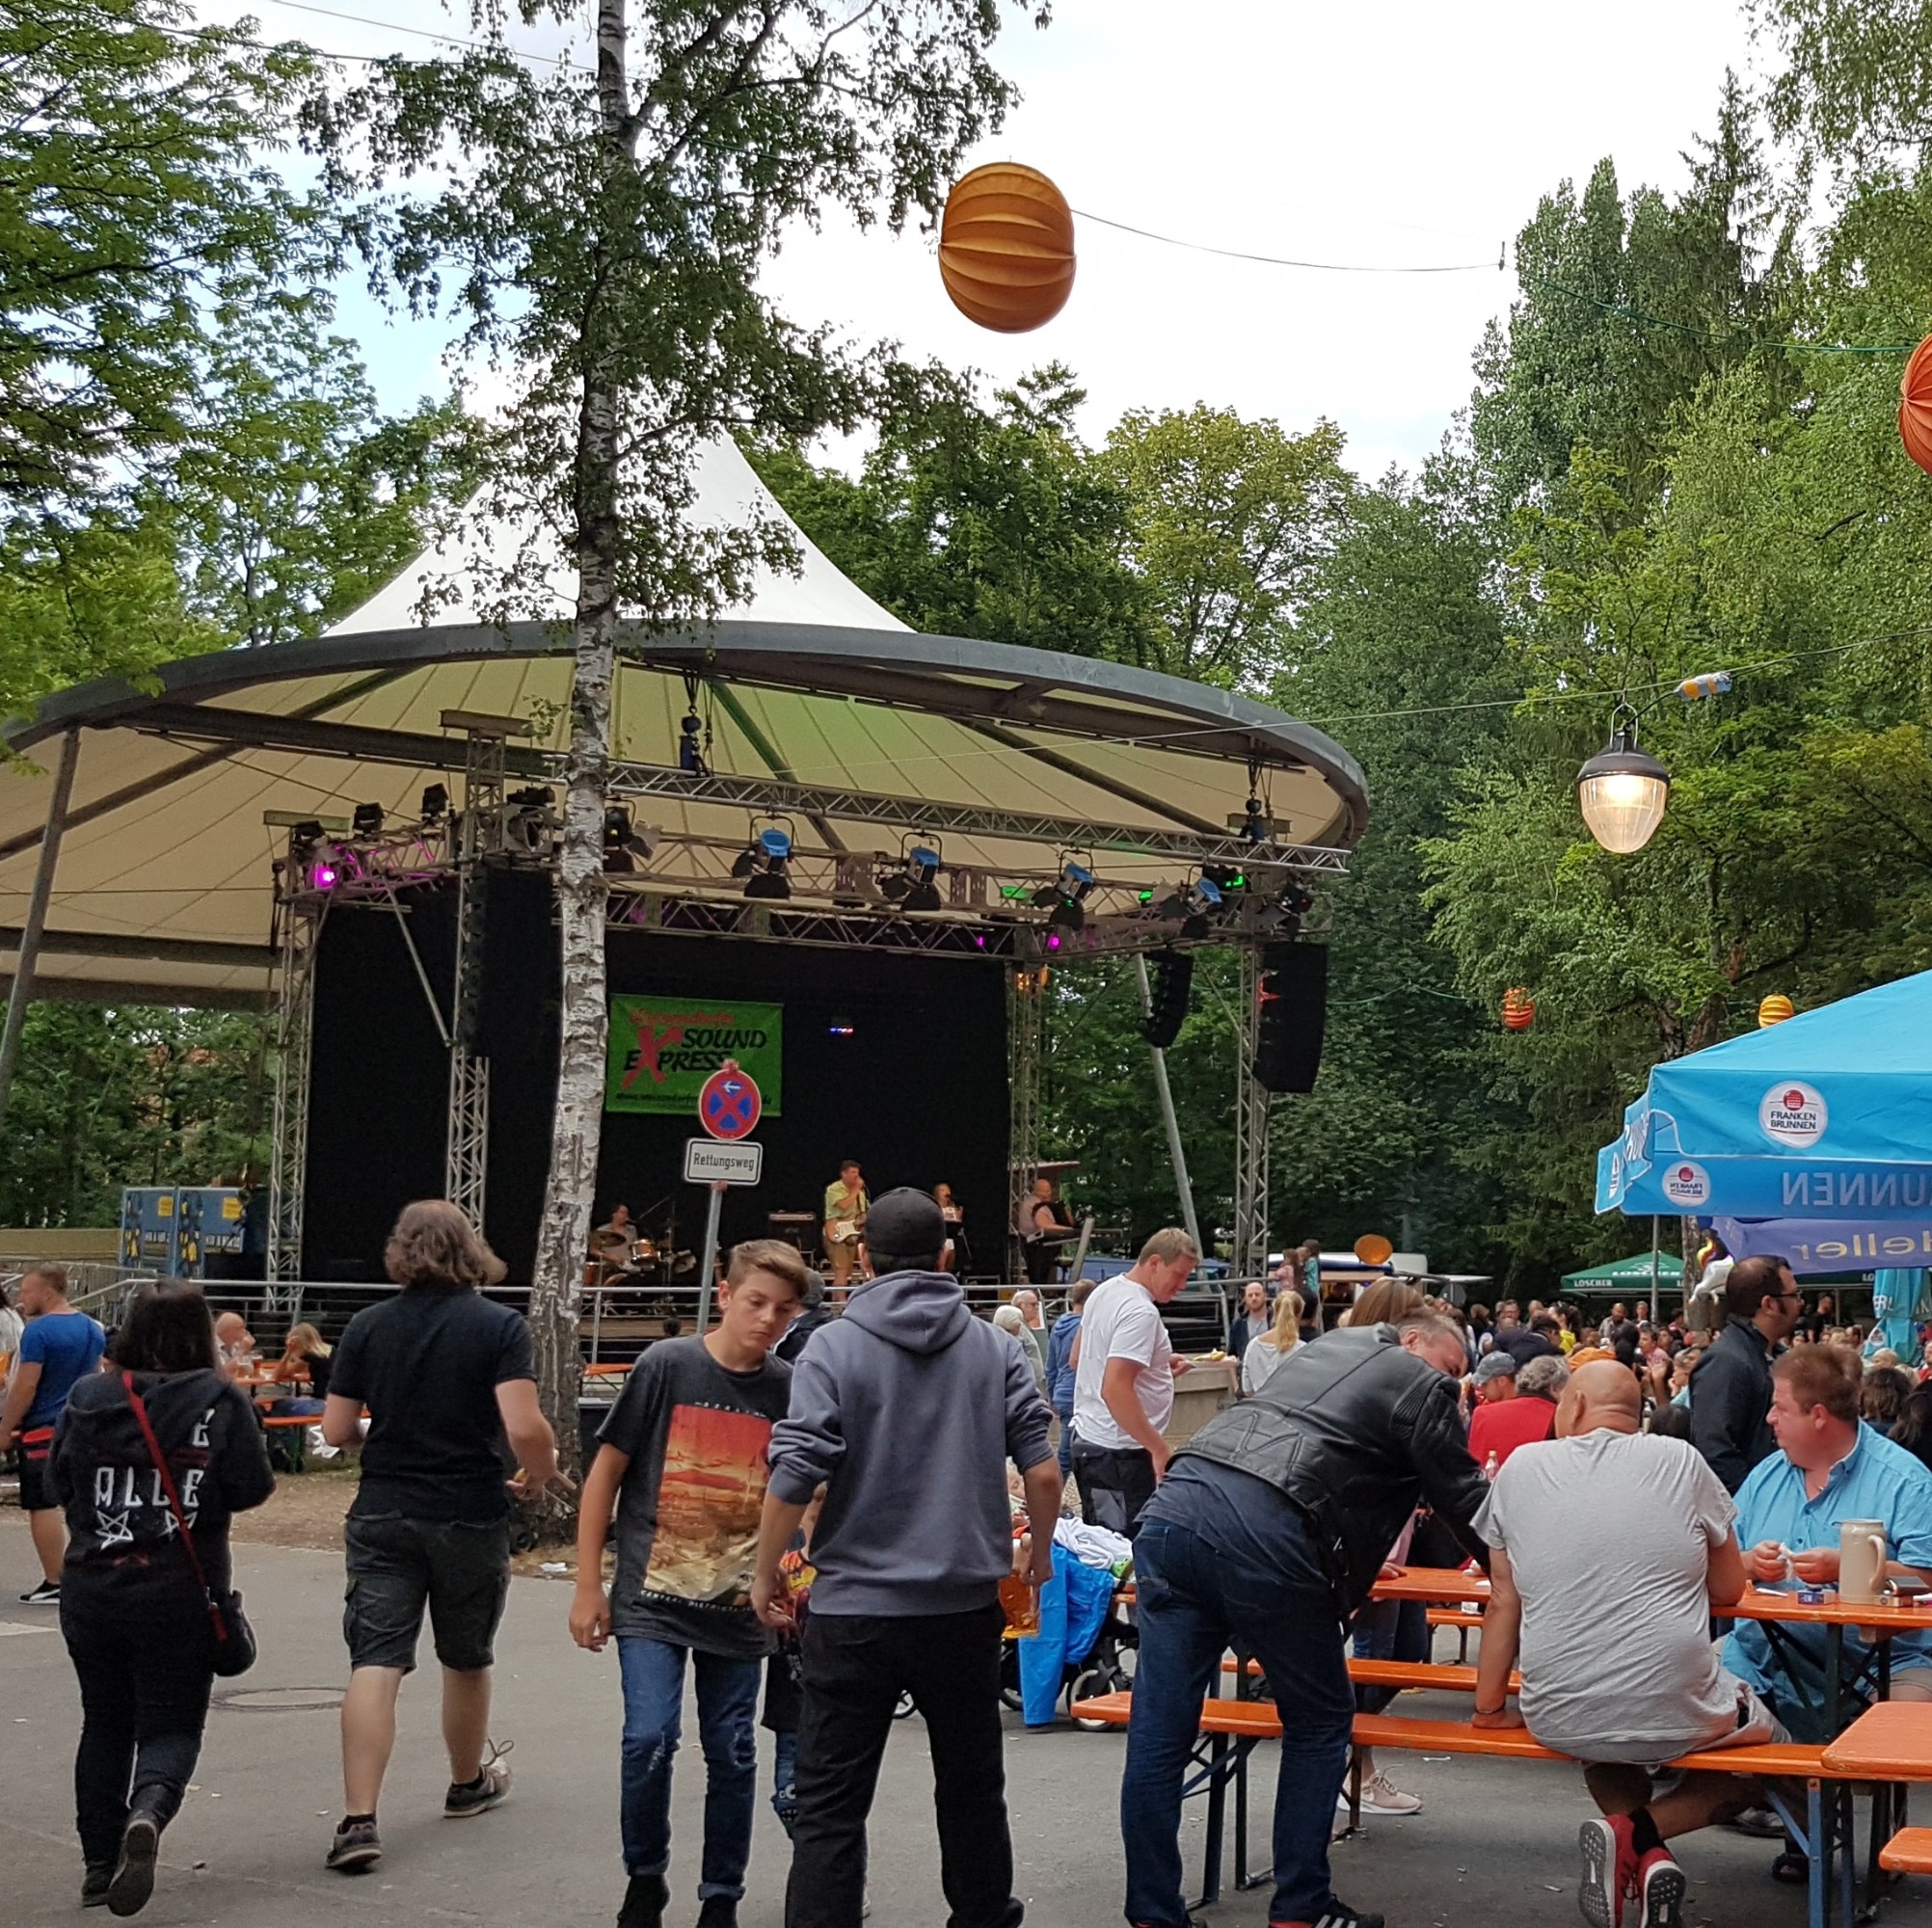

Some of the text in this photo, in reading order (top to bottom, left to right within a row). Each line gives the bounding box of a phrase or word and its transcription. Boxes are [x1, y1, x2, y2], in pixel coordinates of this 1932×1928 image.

[681, 1028, 767, 1050] SOUND
[1770, 1111, 1816, 1120] FRANKEN
[1770, 1119, 1816, 1129] BRUNNEN
[694, 1152, 755, 1172] Rettungsweg
[94, 1466, 204, 1507] ALLE
